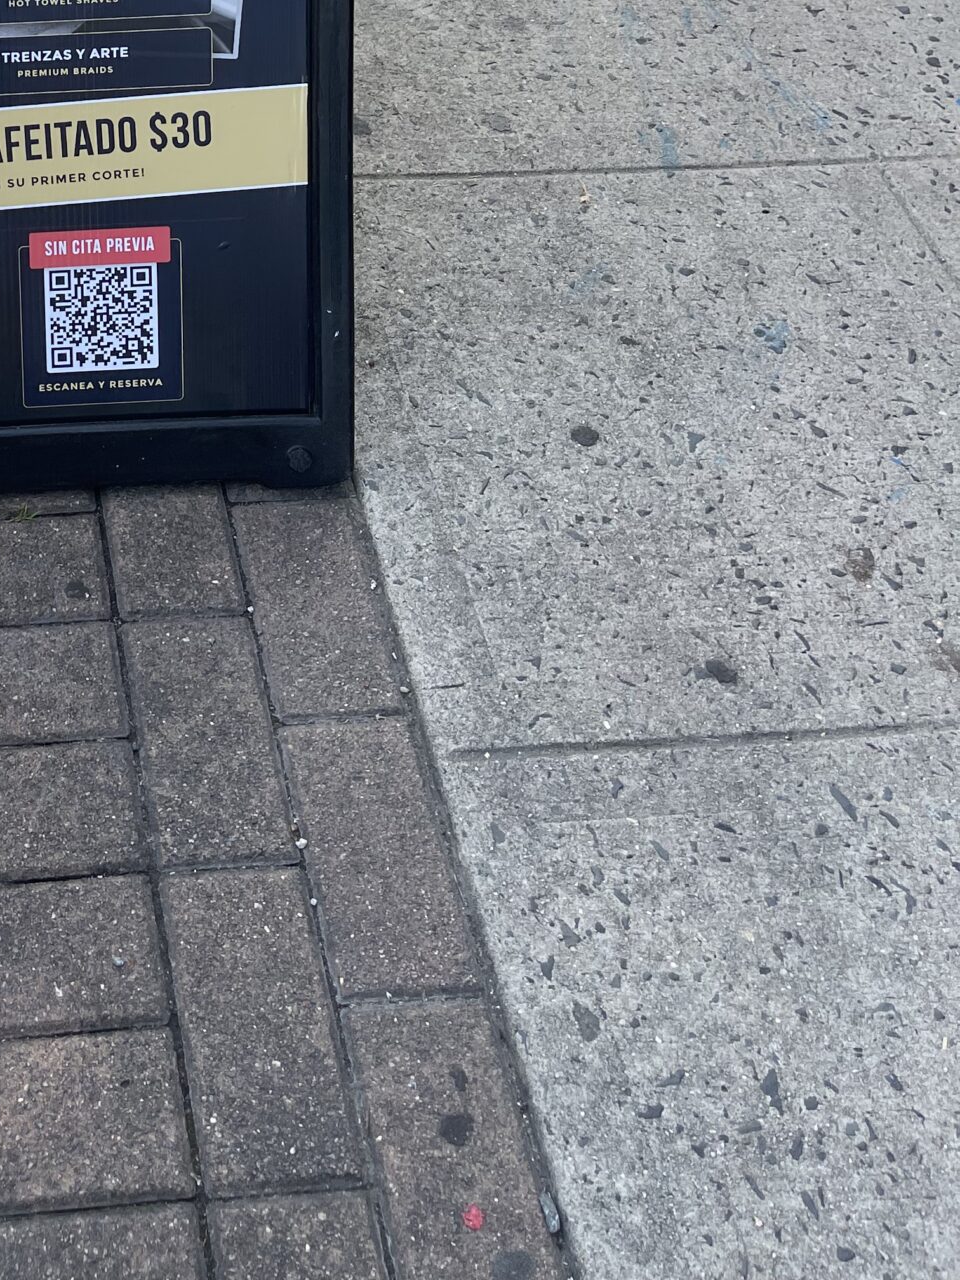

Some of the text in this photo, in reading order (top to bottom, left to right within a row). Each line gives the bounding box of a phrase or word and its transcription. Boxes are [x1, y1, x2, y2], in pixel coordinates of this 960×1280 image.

[8, 0, 31, 8] HOT
[1, 47, 129, 64] TRENZAS Y ARTE
[17, 65, 114, 78] PREMIUM BRAIDS
[149, 109, 213, 151] $30
[7, 177, 26, 189] SU
[30, 173, 87, 187] PRIMER
[92, 168, 146, 182] CORTE!
[44, 236, 155, 256] SIN CITA PREVIA
[38, 378, 163, 392] ESCANEA Y RESERVA
